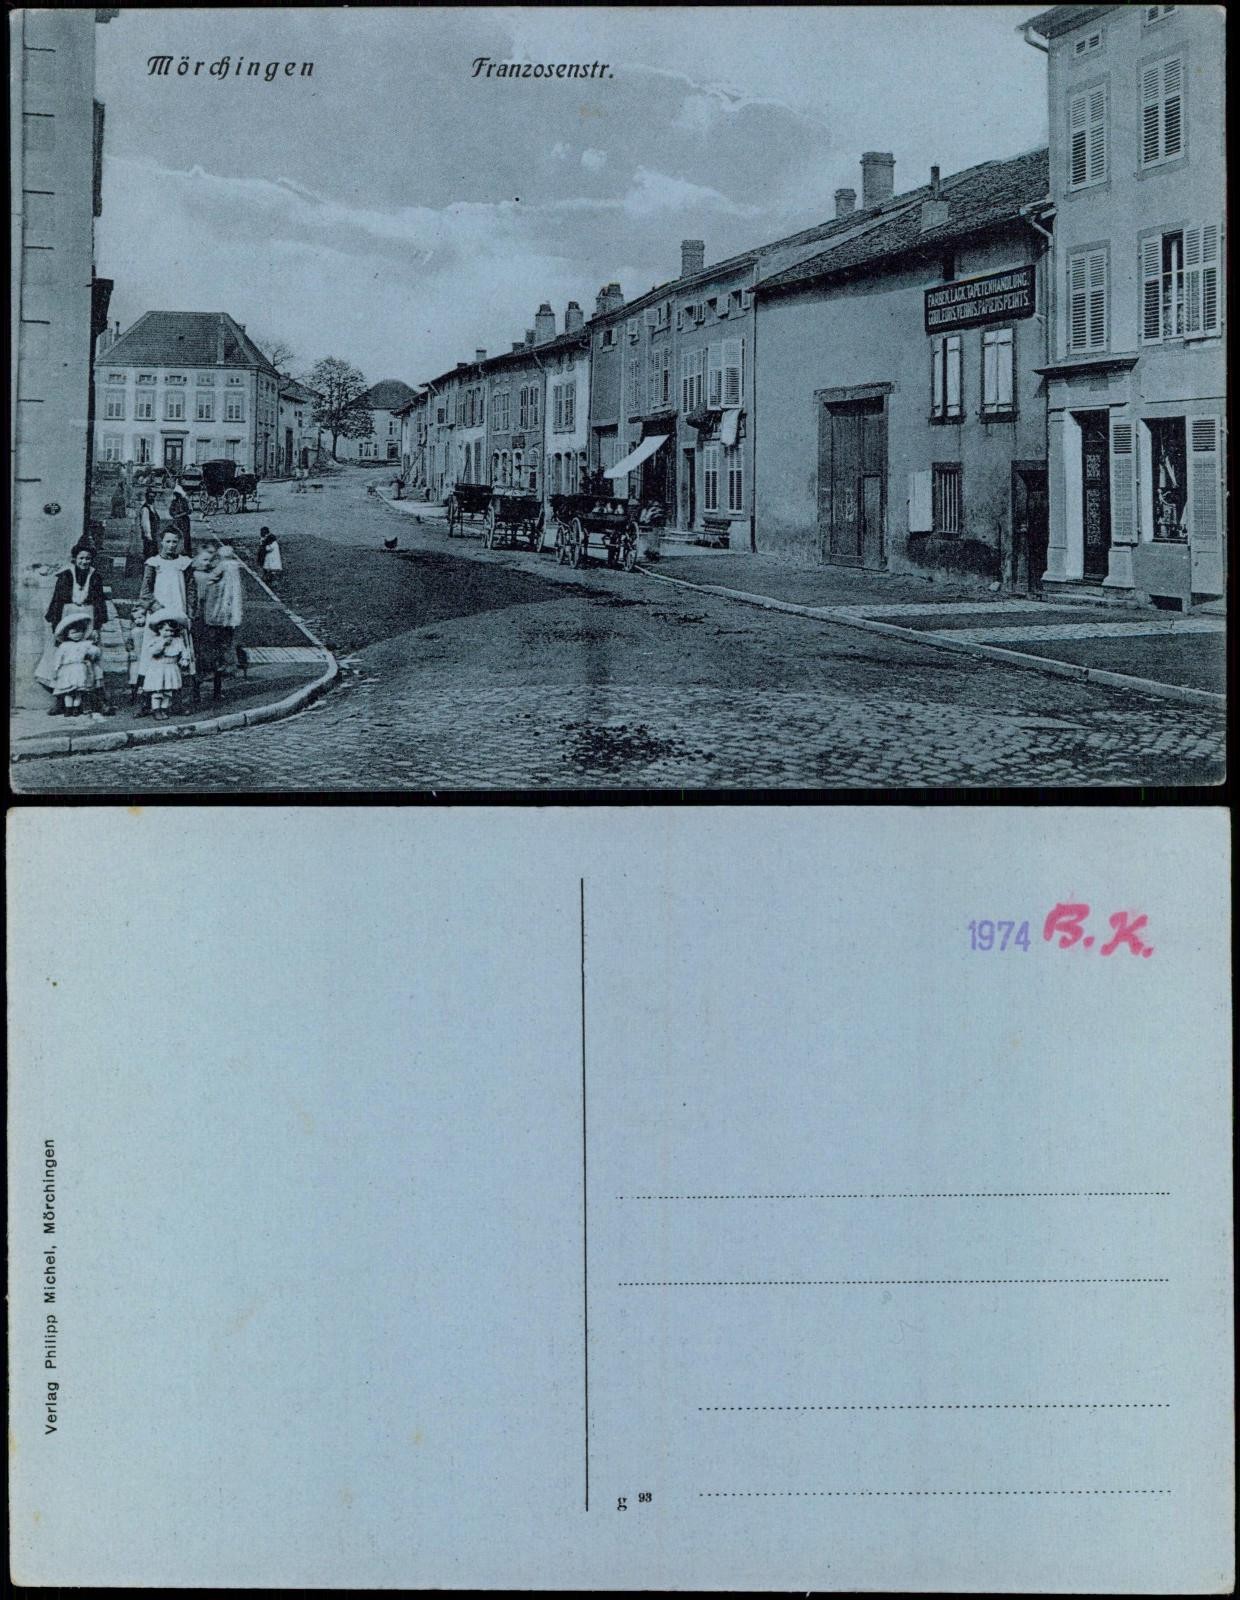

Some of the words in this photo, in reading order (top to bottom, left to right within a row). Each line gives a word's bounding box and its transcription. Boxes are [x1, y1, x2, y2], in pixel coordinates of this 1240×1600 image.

[969, 920, 1031, 952] 1974
[42, 1138, 57, 1235] Mörchingen
[44, 1245, 57, 1304] Michel,
[44, 1314, 59, 1369] Philipp
[44, 1381, 60, 1435] Verlag
[638, 1492, 652, 1503] 93
